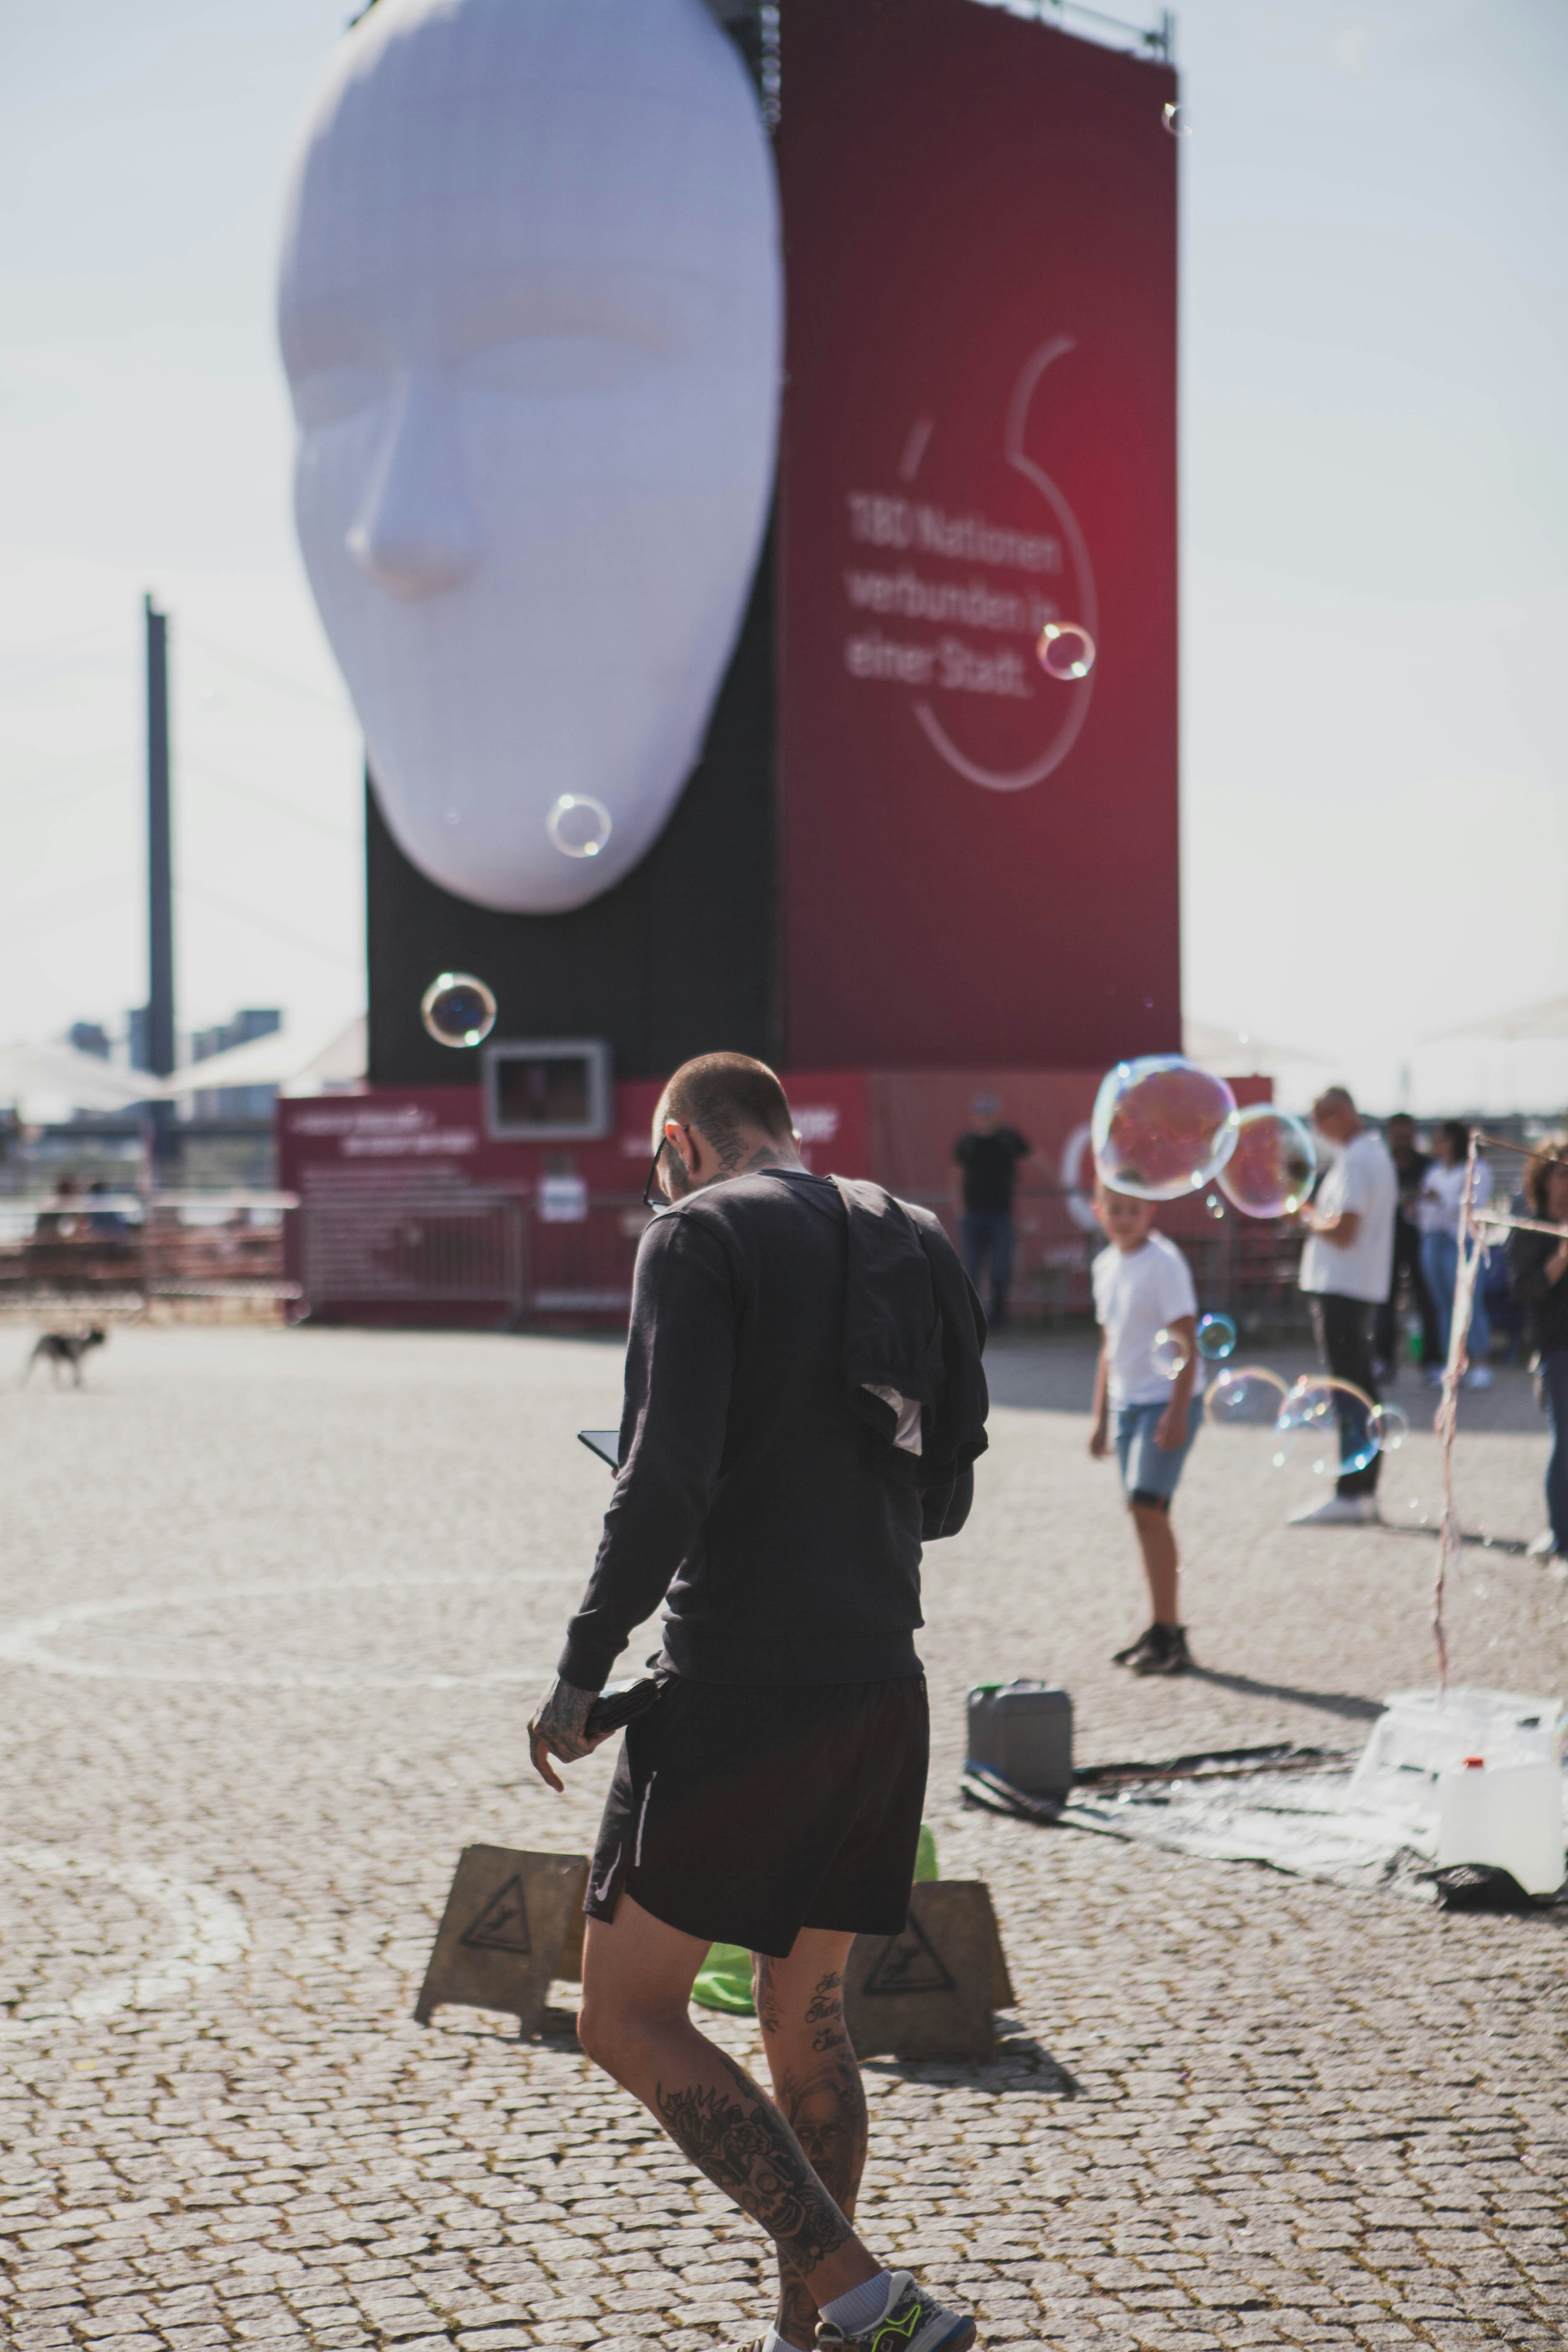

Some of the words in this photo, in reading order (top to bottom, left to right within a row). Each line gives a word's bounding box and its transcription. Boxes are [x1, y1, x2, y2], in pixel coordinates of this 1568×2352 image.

[916, 503, 1063, 575] Nationen
[843, 568, 1024, 632] verbunden
[844, 627, 934, 683] einer
